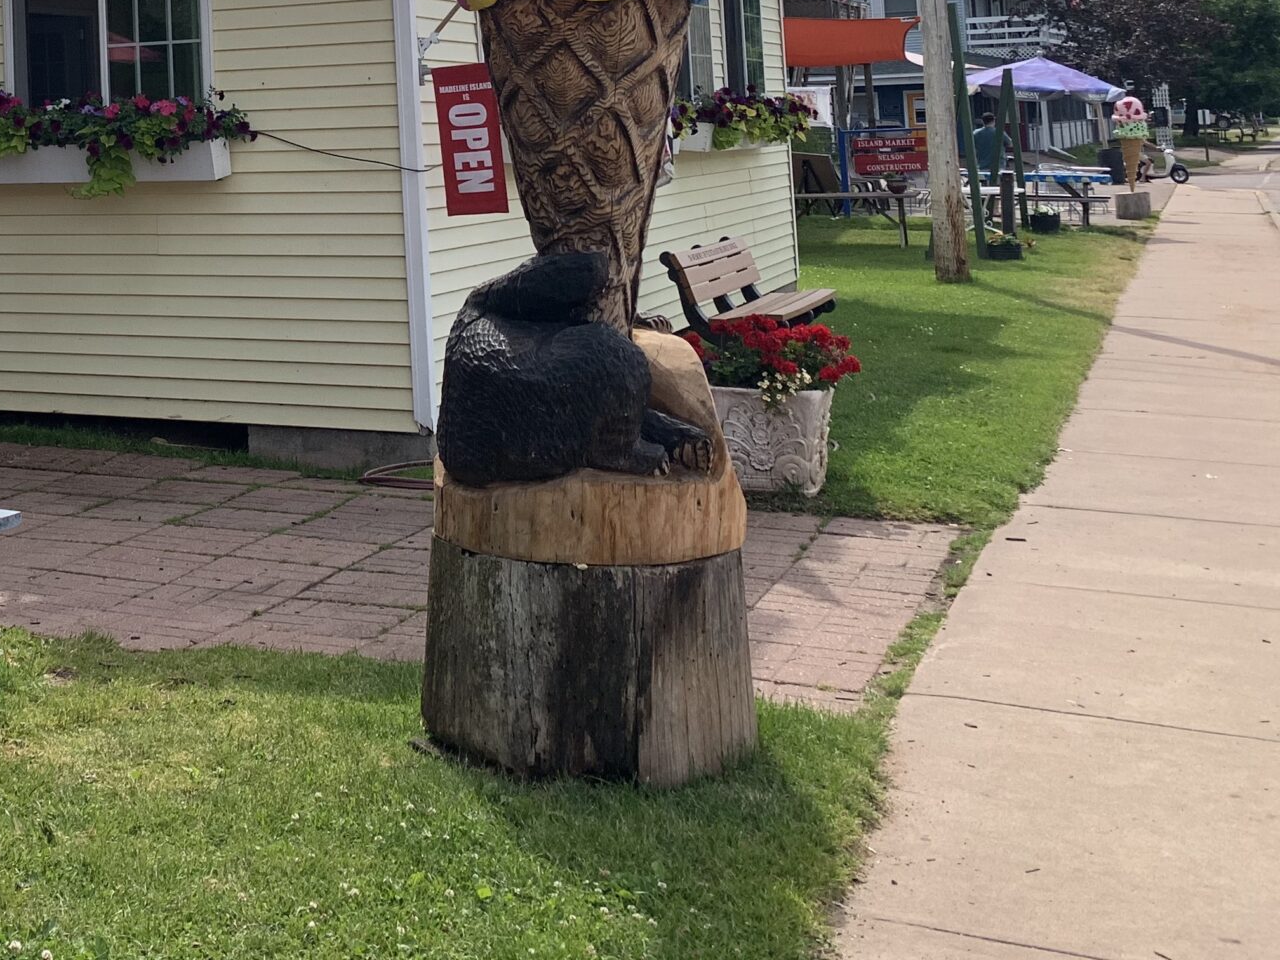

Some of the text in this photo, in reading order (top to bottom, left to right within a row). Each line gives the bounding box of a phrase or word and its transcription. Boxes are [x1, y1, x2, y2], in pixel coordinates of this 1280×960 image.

[439, 81, 492, 94] MADELINE ISLAND
[448, 102, 495, 194] OPEN
[857, 138, 915, 147] ISLAND MARKET
[867, 163, 921, 171] CONSTRUCTION
